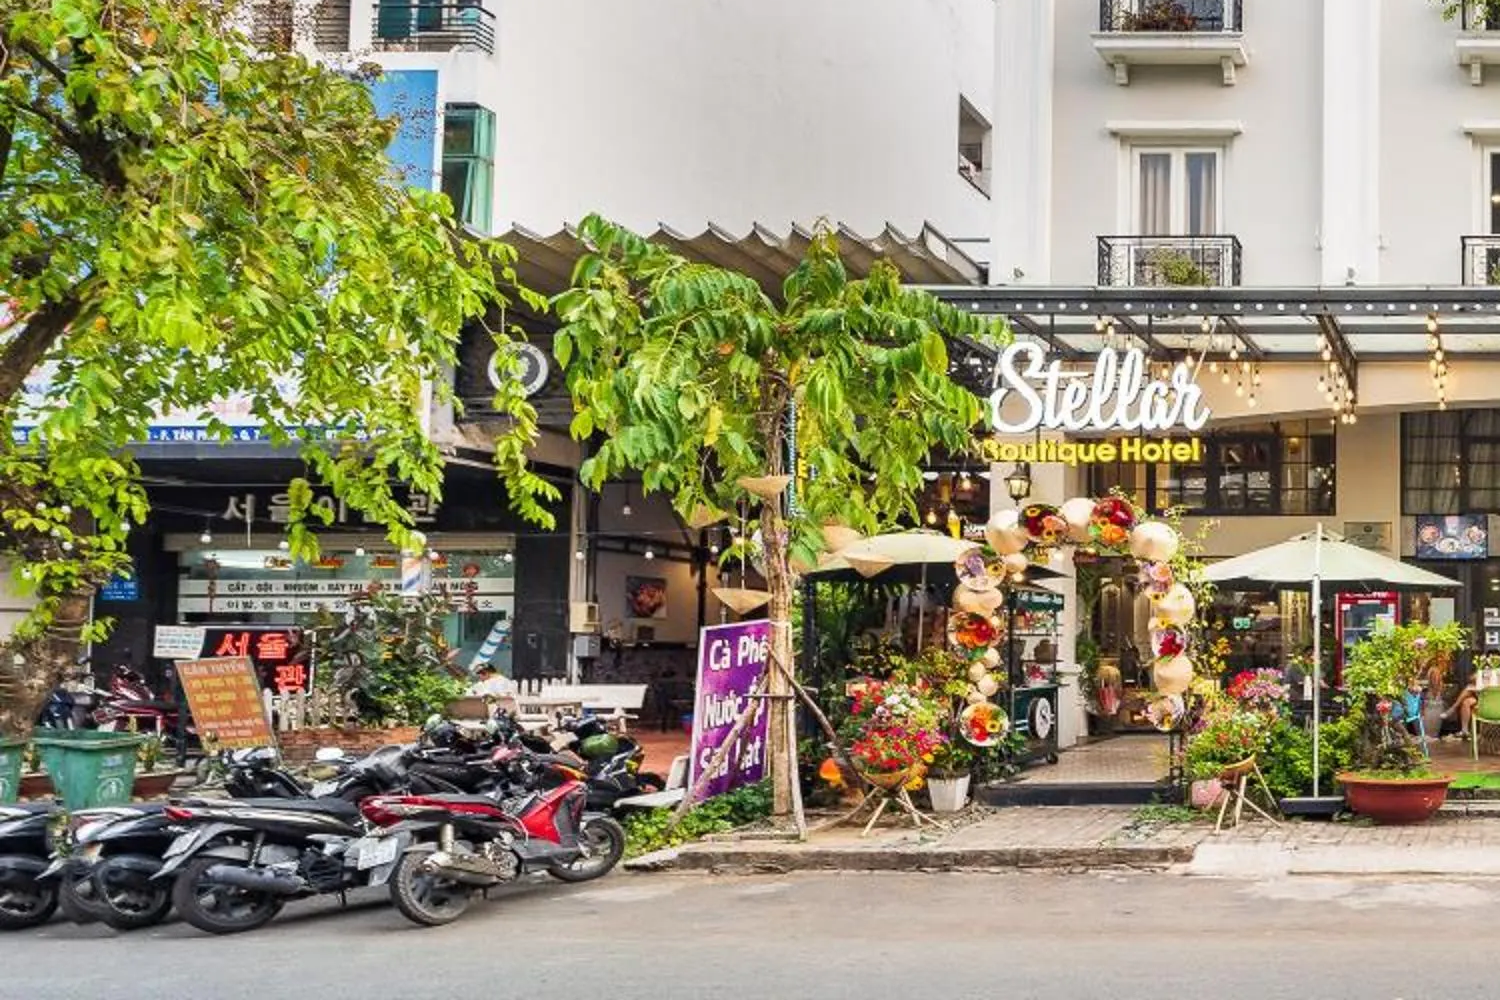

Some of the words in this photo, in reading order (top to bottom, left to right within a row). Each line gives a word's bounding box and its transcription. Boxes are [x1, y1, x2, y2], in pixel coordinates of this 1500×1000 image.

[989, 341, 1210, 433] Stellar
[983, 437, 1117, 467] Boutique
[1121, 437, 1200, 462] Hotel
[216, 632, 289, 659] 서울
[709, 639, 732, 671] Cà
[737, 633, 768, 668] Phê
